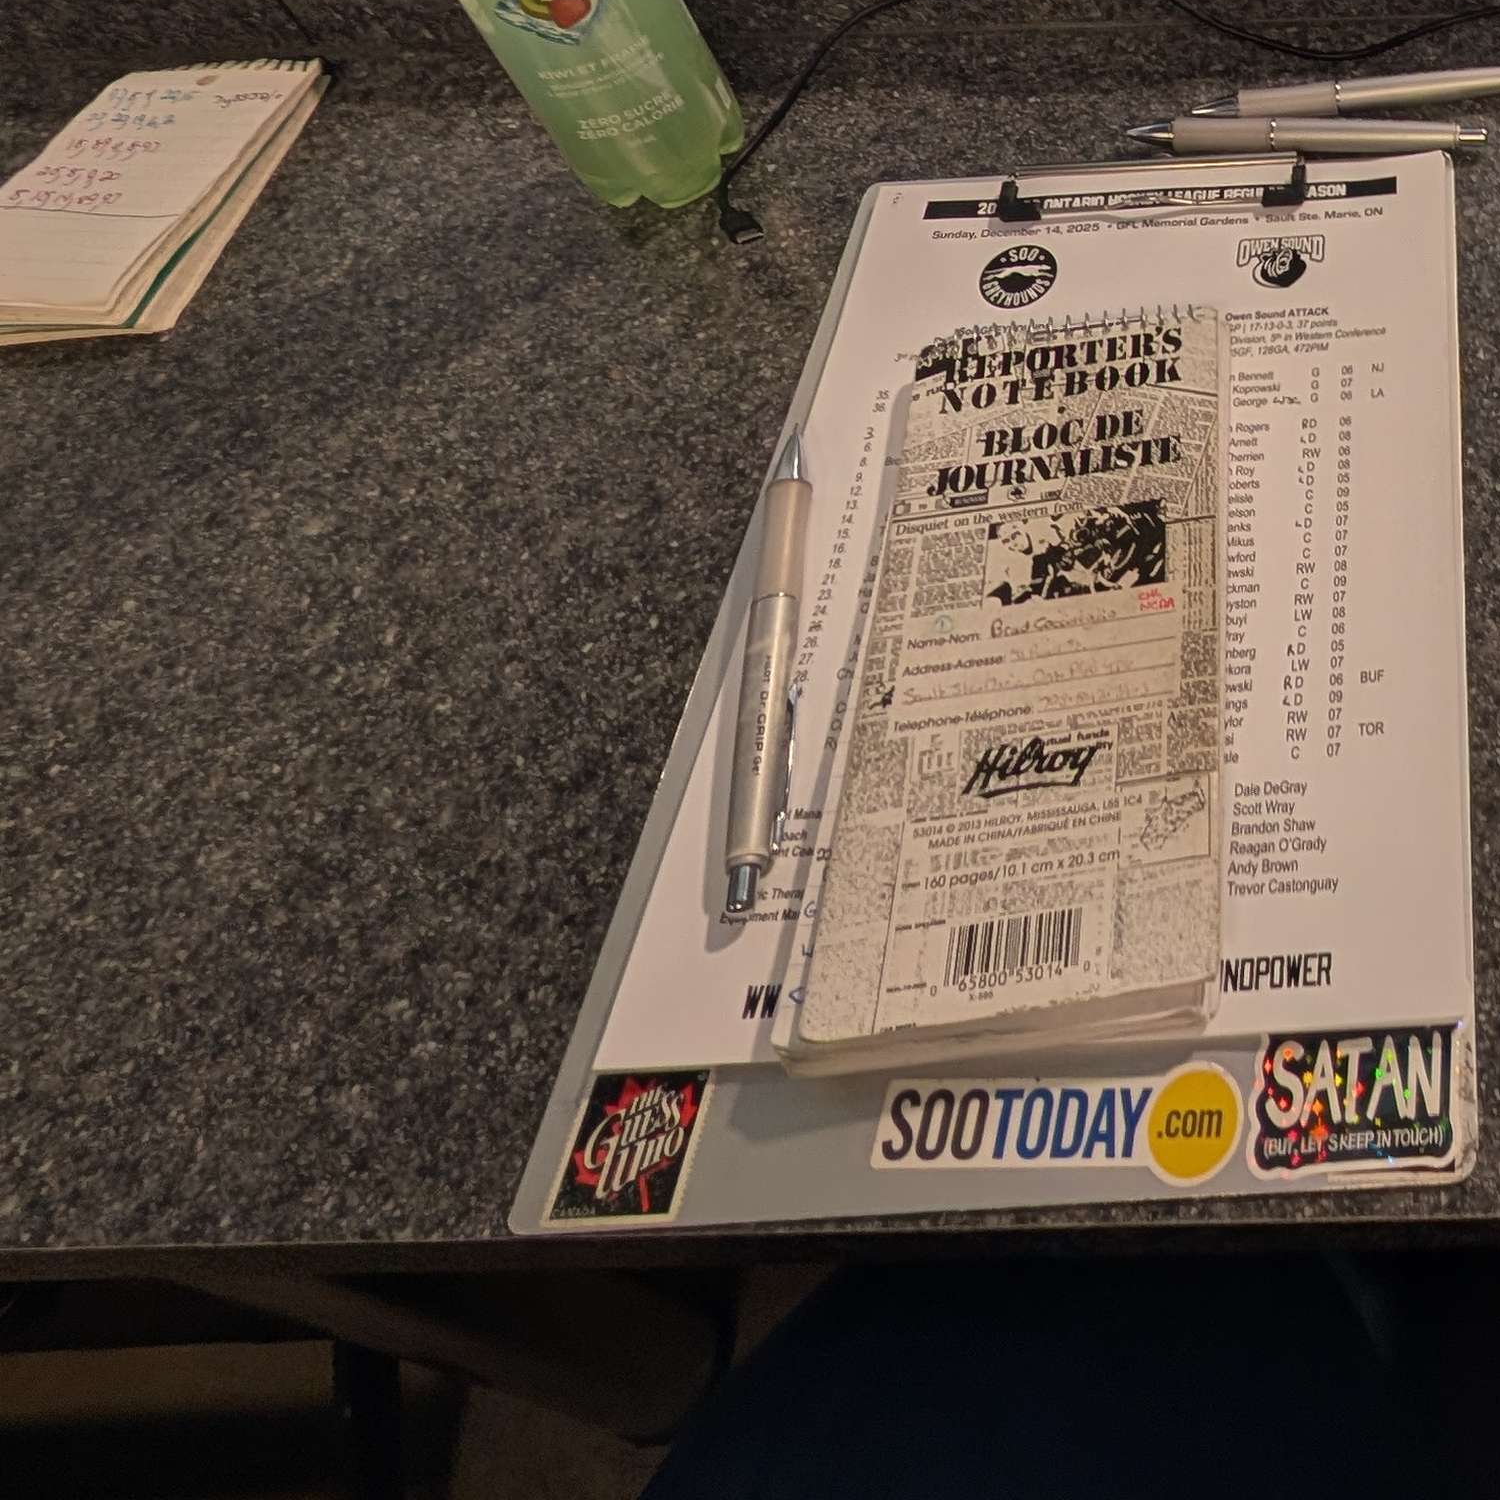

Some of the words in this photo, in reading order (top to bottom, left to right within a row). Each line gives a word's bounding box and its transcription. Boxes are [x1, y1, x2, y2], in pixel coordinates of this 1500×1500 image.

[932, 229, 977, 241] Sunday,
[981, 226, 1042, 238] December
[1045, 225, 1064, 236] 14,
[1067, 223, 1100, 234] 2025
[1116, 220, 1140, 231] GFL
[1141, 217, 1198, 229] Memorial
[1199, 215, 1249, 227] Gardens
[1265, 213, 1297, 224] Sault
[1299, 211, 1322, 222] Ste.
[1324, 209, 1362, 221] Marie,
[1364, 206, 1384, 217] ON
[1009, 247, 1038, 262] SOO
[1237, 237, 1281, 267] OWEN
[1281, 234, 1326, 263] SOUND
[981, 275, 1052, 306] GREYHOUNDS
[1225, 312, 1252, 323] Owen
[1255, 309, 1286, 320] Sound
[1288, 306, 1329, 318] ATTACK
[944, 327, 1183, 385] REPORTER'S
[939, 357, 1182, 414] NOTEBOOK
[1233, 383, 1281, 395] Koprowski
[977, 418, 1083, 458] BLOC
[1096, 409, 1145, 441] DE
[927, 434, 1182, 497] JOURNALISTE
[895, 518, 949, 537] Disquiet
[954, 516, 971, 528] on
[973, 510, 994, 526] the
[998, 504, 1048, 522] western
[907, 631, 982, 650] Name-Nom:
[902, 654, 1006, 677] Address-Adresse:
[1360, 670, 1385, 684] BUF
[962, 737, 1100, 798] Hilroy
[1235, 781, 1260, 797] Dale
[1264, 780, 1308, 797] DeGray
[913, 825, 943, 840] 53014
[958, 821, 982, 833] 2013
[983, 815, 1022, 829] HILROY,
[1027, 803, 1100, 822] MISSISSAUGA,
[1233, 802, 1262, 816] Scott
[1265, 799, 1295, 815] Wray
[928, 837, 961, 850] MADE
[963, 834, 976, 845] IN
[1072, 816, 1094, 829] EN
[1095, 811, 1122, 824] CHINE
[1231, 820, 1280, 836] Brandon
[1283, 818, 1316, 833] Shaw
[1230, 840, 1275, 857] Reagan
[1279, 837, 1327, 854] O'Grady
[923, 875, 946, 890] 160
[949, 861, 1027, 888] pages/10.1
[1030, 860, 1053, 873] cm
[1056, 860, 1064, 870] x
[1068, 853, 1095, 869] 20.3
[1098, 849, 1121, 863] cm
[1228, 860, 1258, 877] Andy
[1261, 858, 1299, 874] Brown
[1228, 880, 1266, 896] Trevor
[1268, 876, 1339, 894] Castonguay
[957, 968, 1008, 993] 65800
[1265, 1030, 1443, 1129] SATAN
[881, 1085, 1150, 1160] SOOTODAY
[1155, 1106, 1224, 1140] .com
[1340, 1130, 1374, 1150] KEEP
[1376, 1129, 1392, 1148] IN
[1393, 1124, 1444, 1147] TOUCH)
